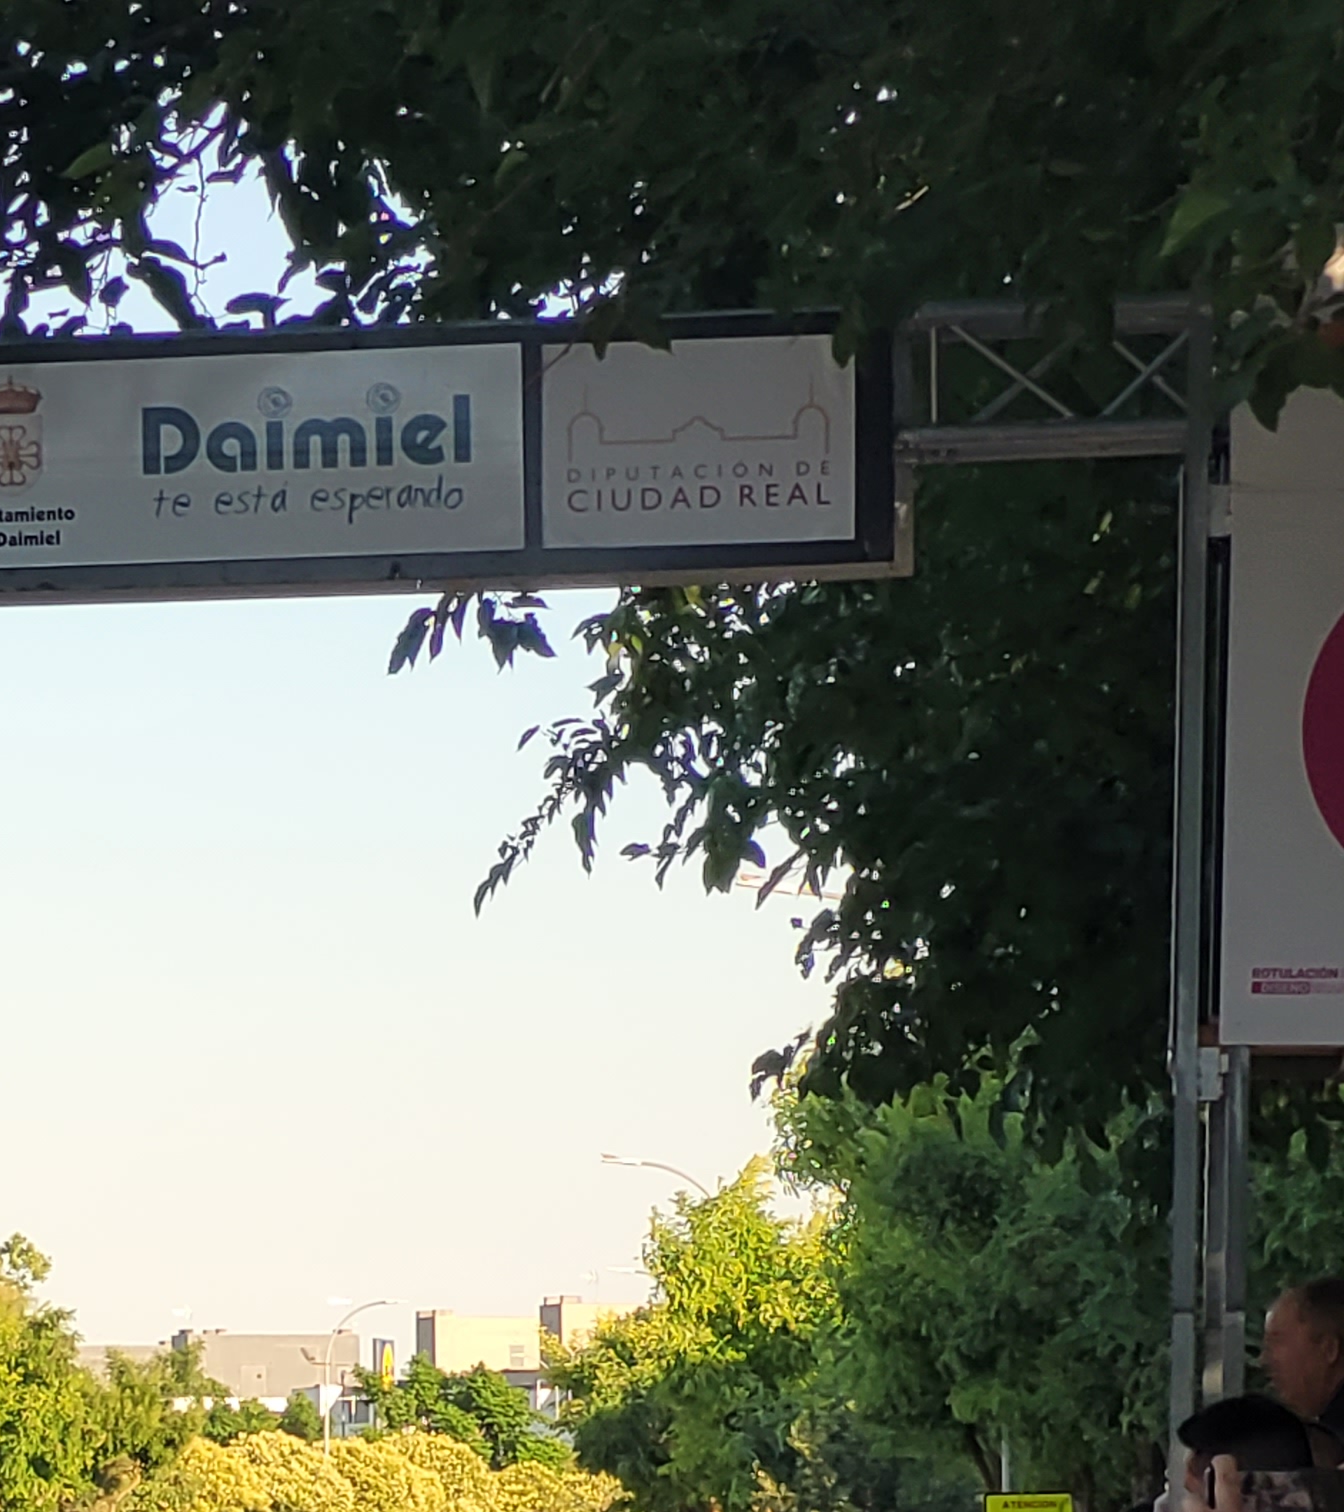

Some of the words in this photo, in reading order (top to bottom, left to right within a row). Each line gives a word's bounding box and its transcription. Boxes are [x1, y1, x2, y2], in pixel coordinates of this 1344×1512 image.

[142, 383, 472, 475] Daimiel
[567, 460, 774, 483] DIPUTACIÓN
[796, 459, 831, 477] DE
[153, 488, 192, 518] te
[215, 481, 288, 516] está
[310, 474, 464, 526] esperando
[567, 484, 723, 513] CIUDAD
[739, 481, 832, 508] REAL
